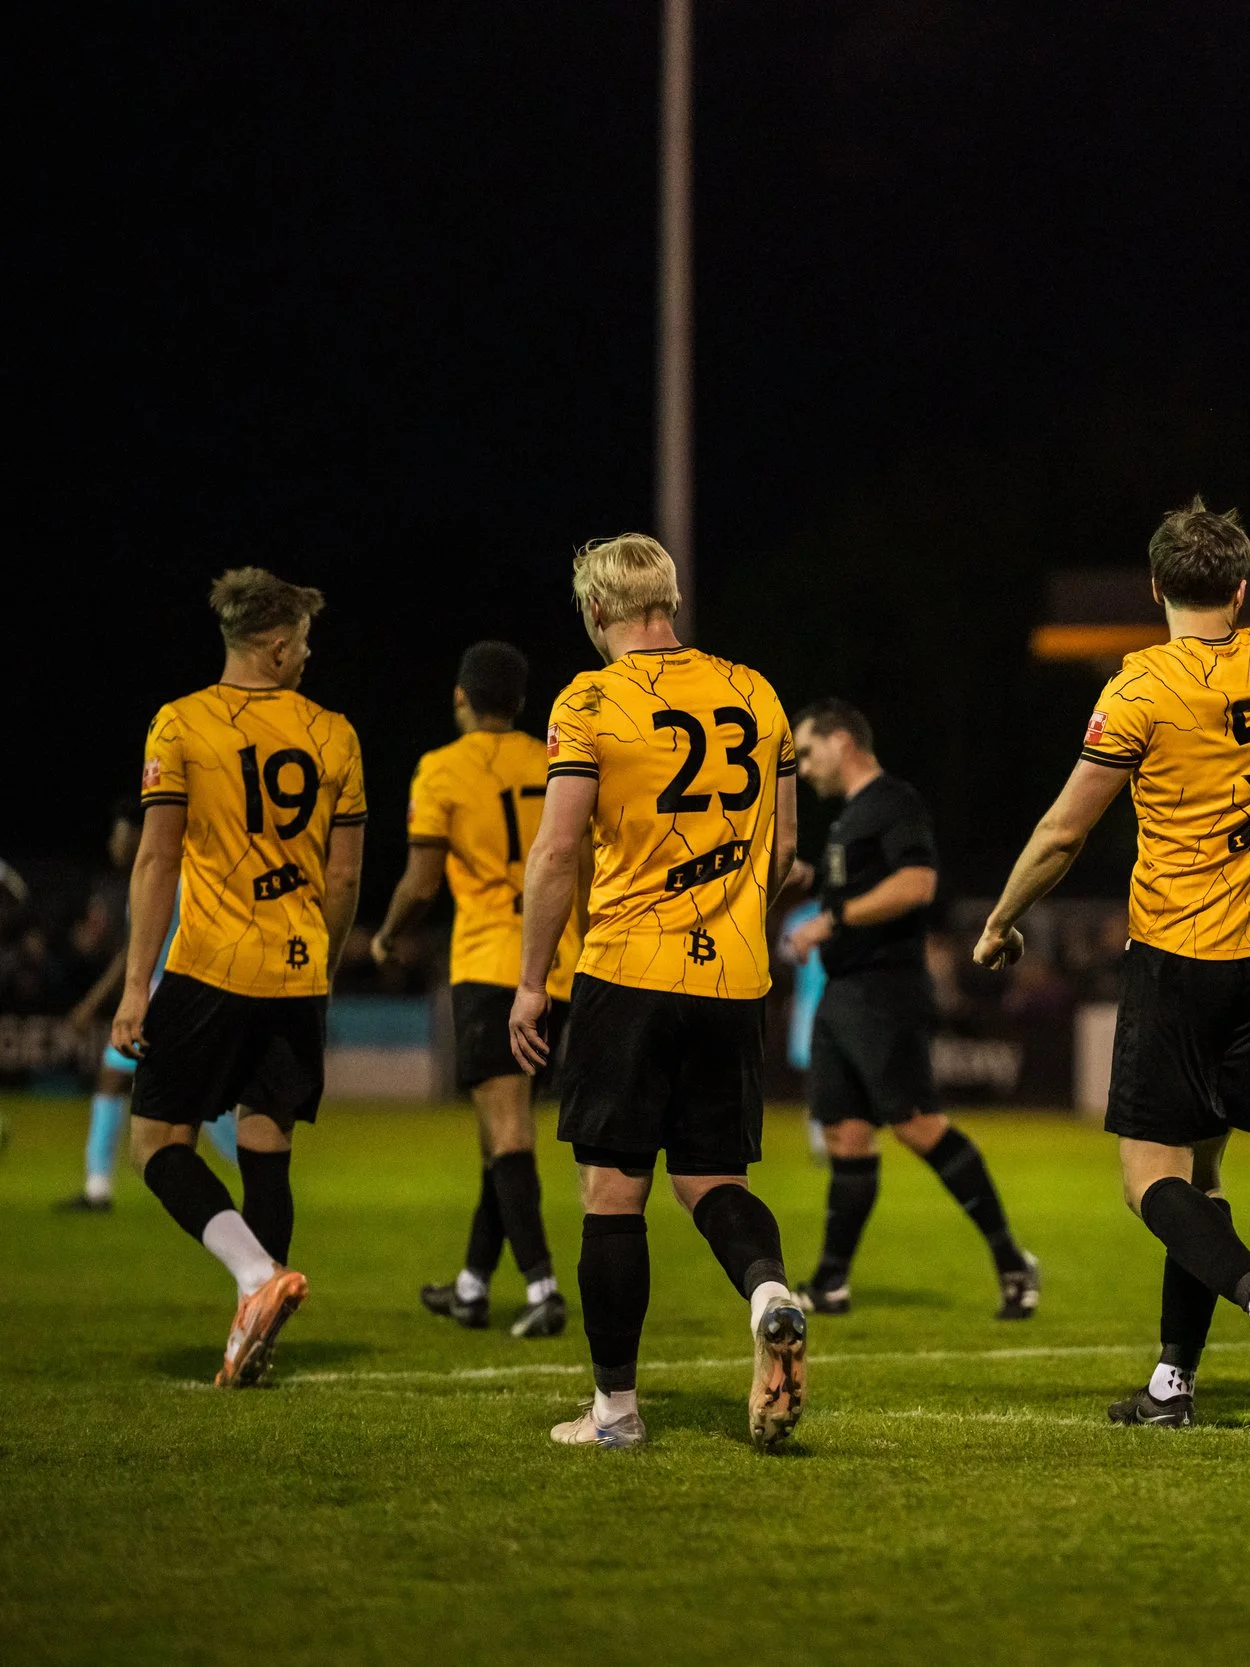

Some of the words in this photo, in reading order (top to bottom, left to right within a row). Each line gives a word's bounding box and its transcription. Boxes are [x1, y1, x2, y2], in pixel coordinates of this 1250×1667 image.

[237, 744, 320, 840] 19
[652, 706, 761, 814] 23
[673, 845, 744, 888] IREN
